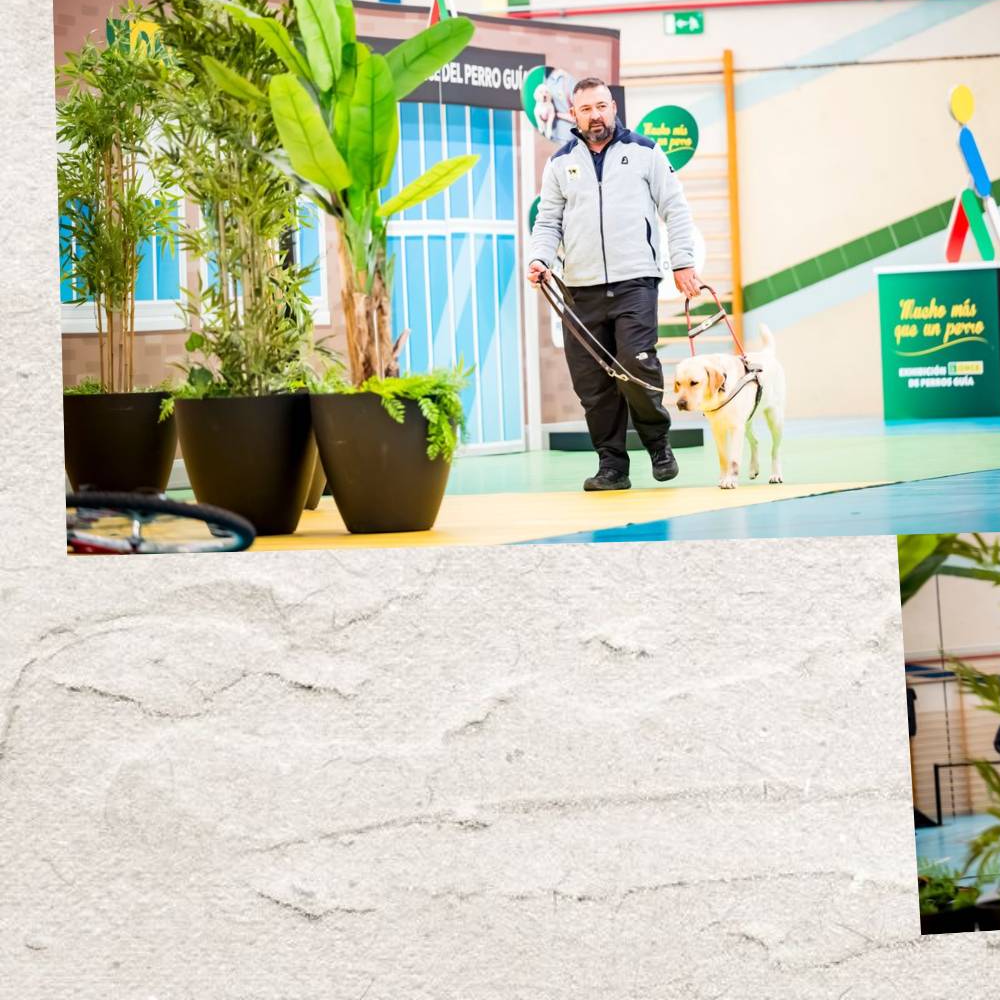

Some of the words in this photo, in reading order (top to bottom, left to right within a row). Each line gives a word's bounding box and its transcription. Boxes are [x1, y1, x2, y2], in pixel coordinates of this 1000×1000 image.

[441, 62, 463, 84] DEL
[464, 64, 501, 89] PERRO
[899, 298, 947, 320] Mucho
[951, 298, 976, 318] más
[895, 324, 918, 345] que
[923, 322, 941, 337] un
[943, 320, 984, 344] perro
